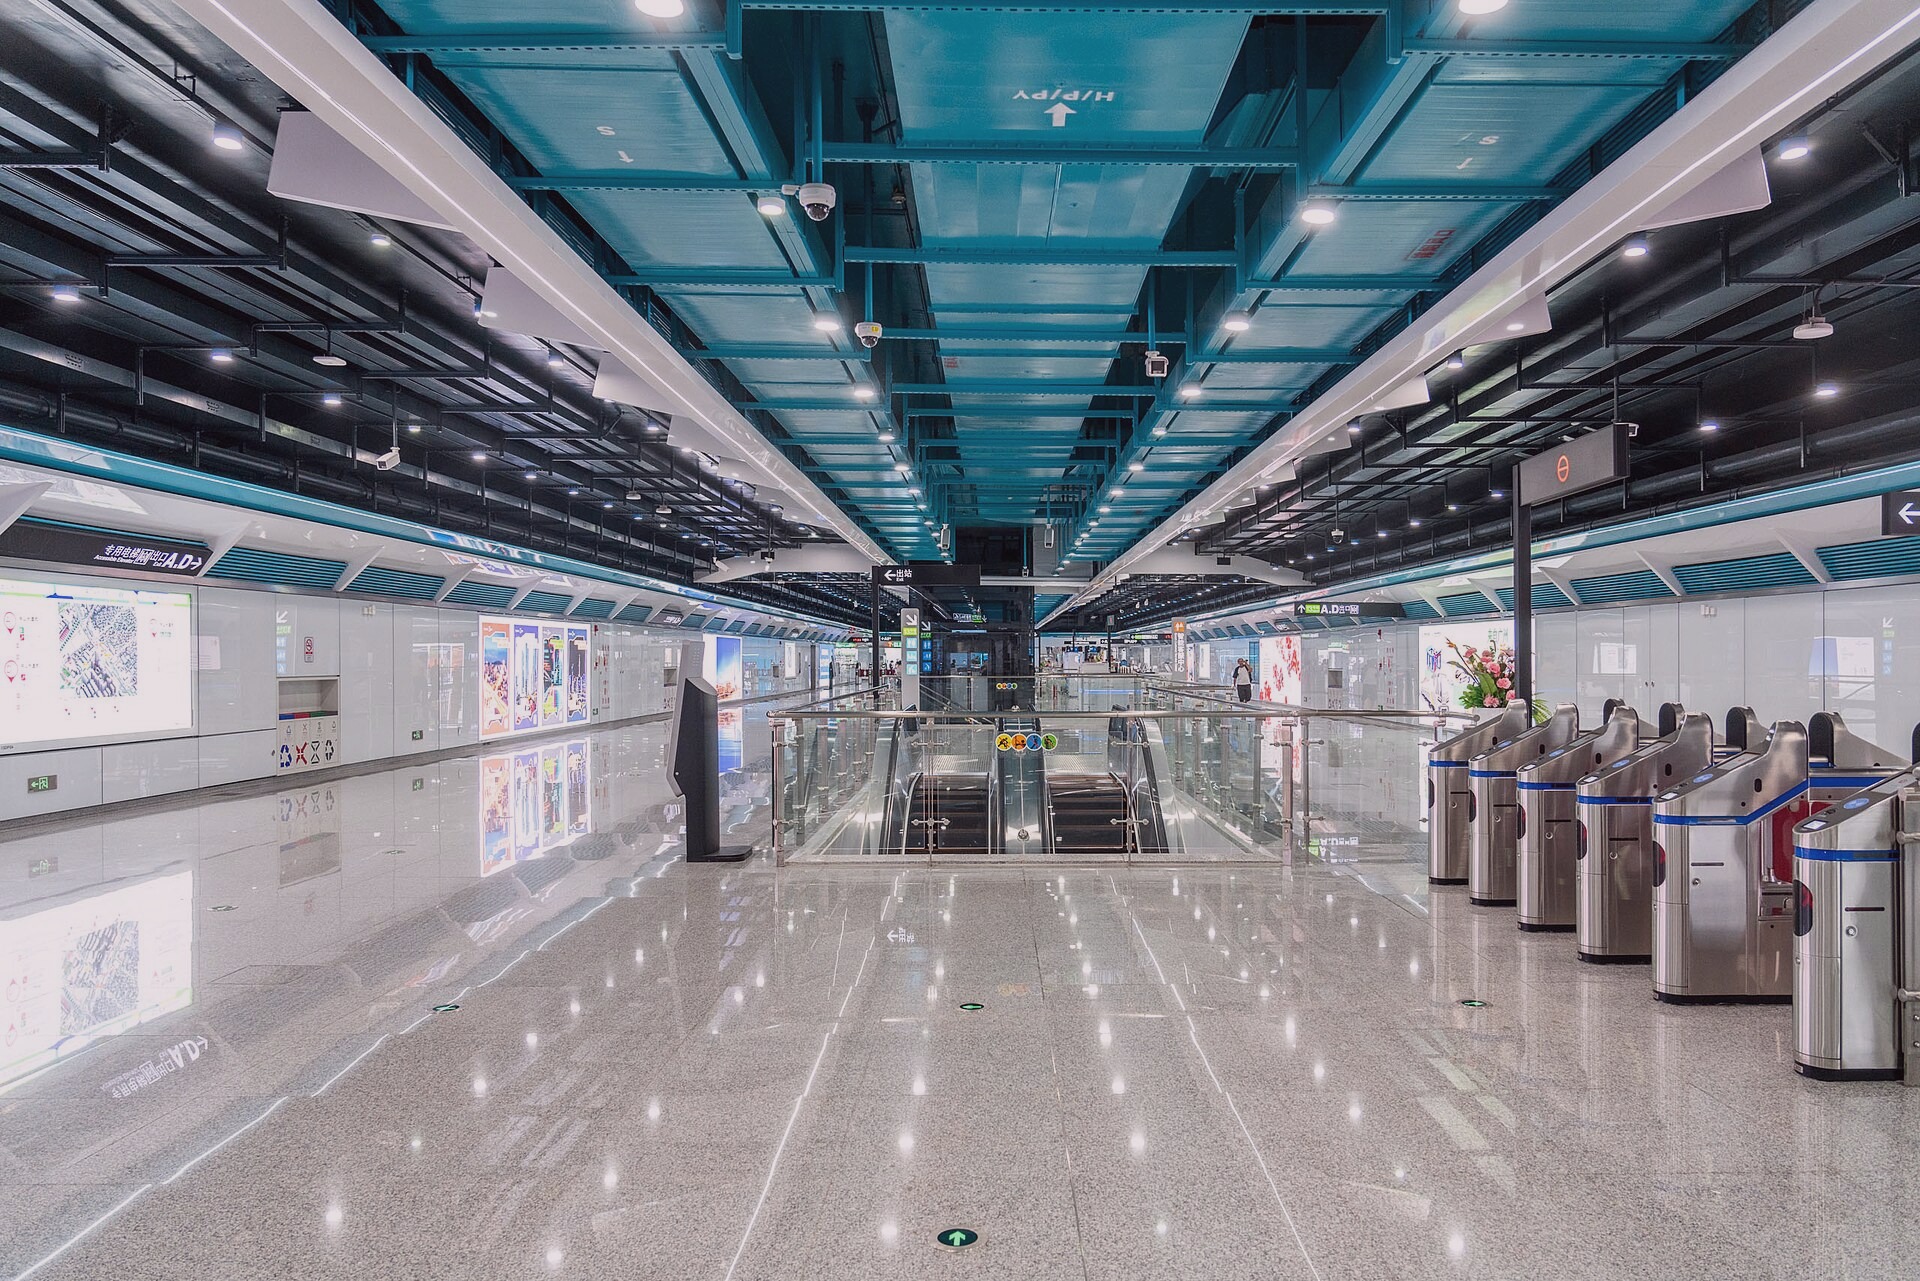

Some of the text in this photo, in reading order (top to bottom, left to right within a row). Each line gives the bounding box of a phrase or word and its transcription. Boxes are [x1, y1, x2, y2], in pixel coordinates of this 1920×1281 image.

[1012, 89, 1114, 101] H/P/PY
[596, 126, 616, 136] S
[105, 544, 193, 569] 专用电梯 出口 A.D
[1321, 604, 1339, 614] A.D
